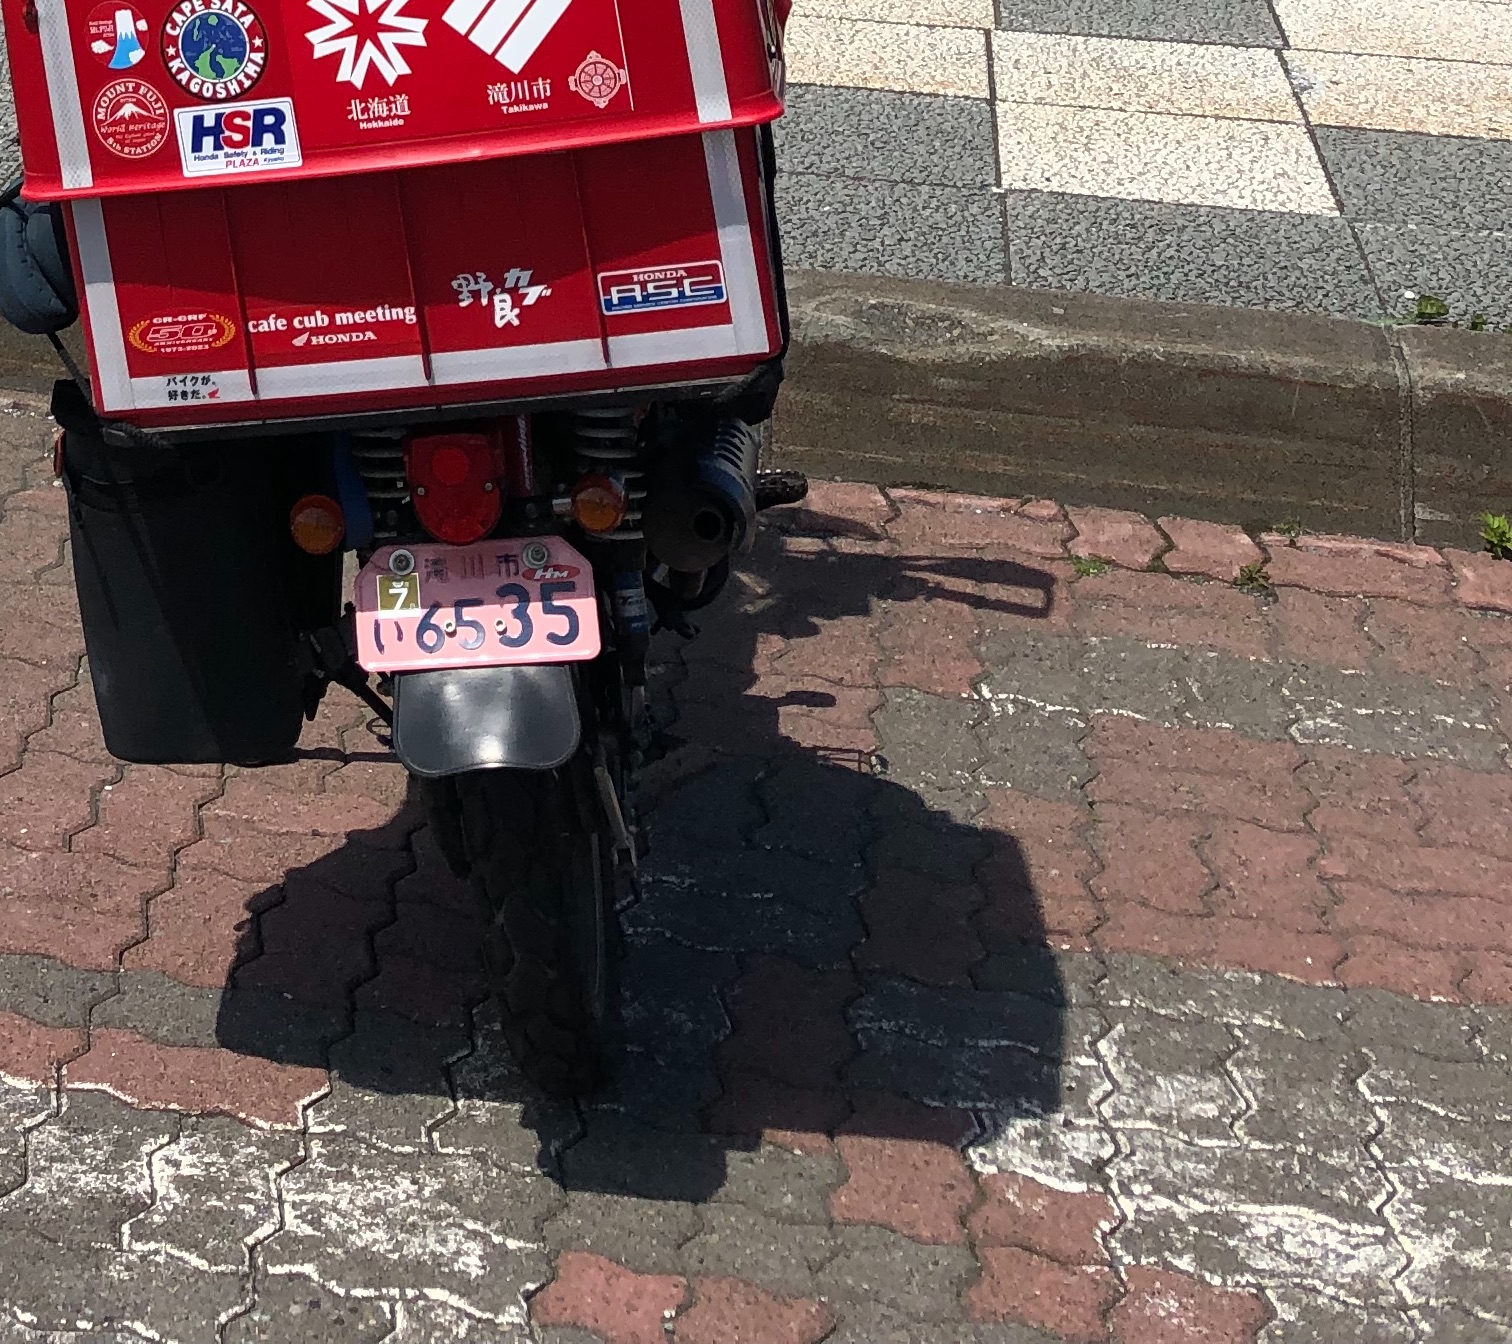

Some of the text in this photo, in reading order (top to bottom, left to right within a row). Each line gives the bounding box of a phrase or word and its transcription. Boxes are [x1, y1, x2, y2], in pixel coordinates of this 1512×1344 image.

[168, 52, 265, 99] KAGOSHIMA
[97, 82, 165, 120] MOUNT FUJI
[487, 76, 551, 105] 滝川市
[346, 93, 411, 121] 北海道
[501, 103, 549, 114] Takikawa
[191, 107, 287, 154] HSR
[359, 118, 404, 130] Hokkaido
[123, 132, 162, 155] STATION
[193, 152, 219, 162] Honda
[223, 150, 248, 160] Safety
[260, 146, 285, 156] Riding
[225, 157, 260, 169] PLAZA
[631, 269, 687, 282] HONDA
[248, 304, 417, 333] cafe cub meeting
[310, 331, 378, 345] HONDA
[388, 587, 408, 611] 7
[374, 580, 580, 655] い 6535
